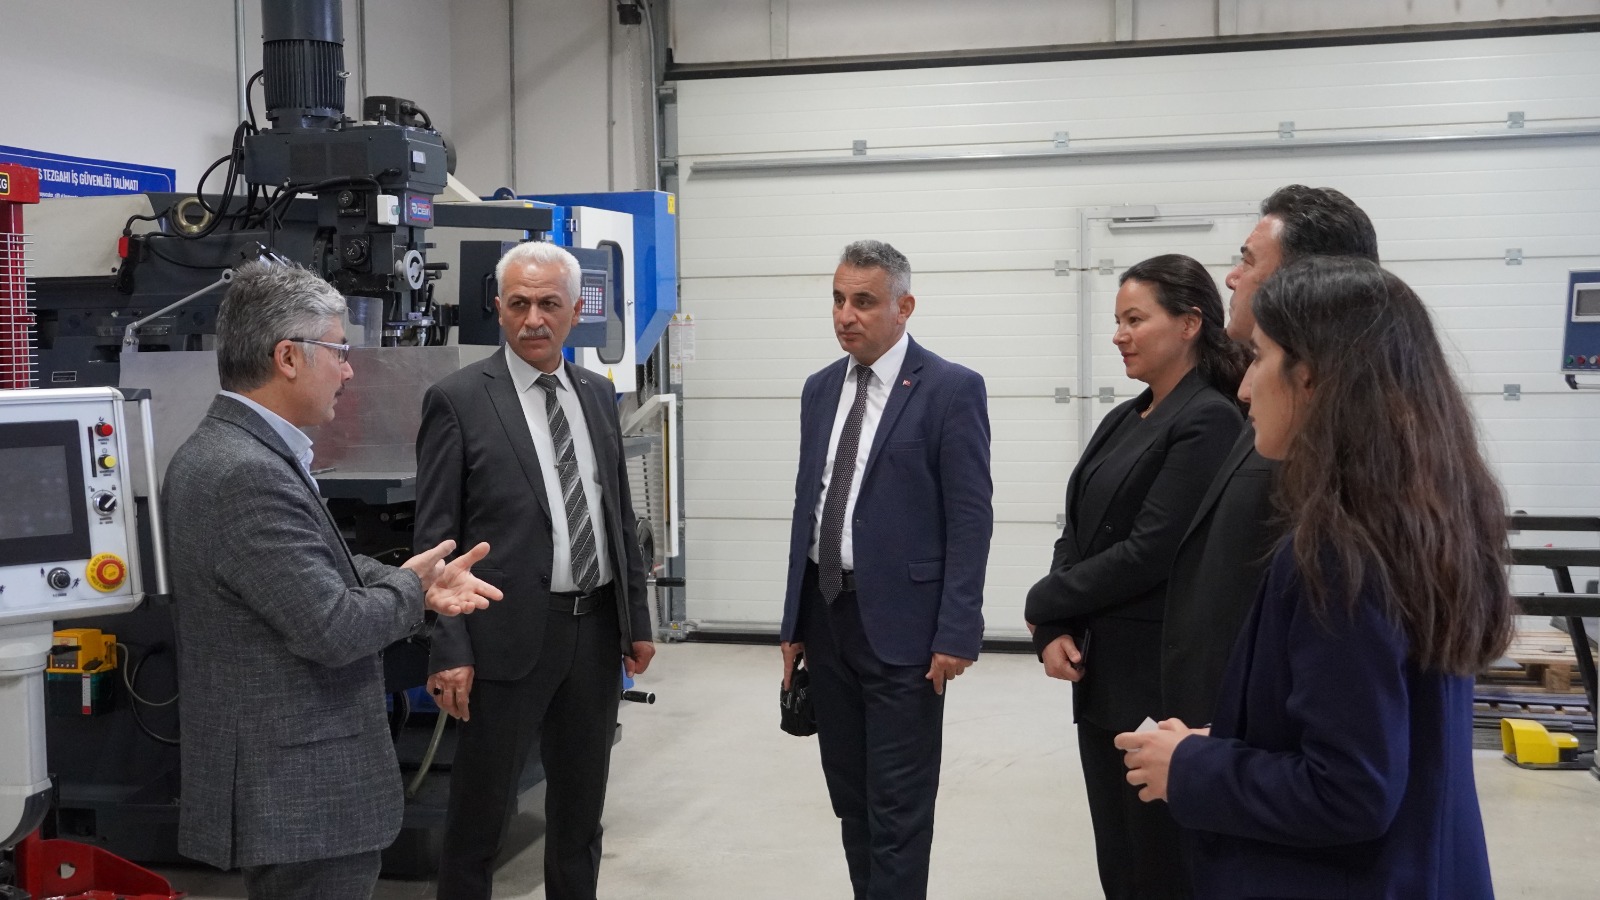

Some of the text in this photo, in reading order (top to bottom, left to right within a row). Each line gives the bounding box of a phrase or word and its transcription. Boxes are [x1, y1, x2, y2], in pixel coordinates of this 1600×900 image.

[43, 169, 71, 183] TEZGAHI
[71, 169, 79, 186] İŞ
[79, 171, 112, 188] GÜVENLİĞİ
[113, 176, 139, 191] TALİMATI
